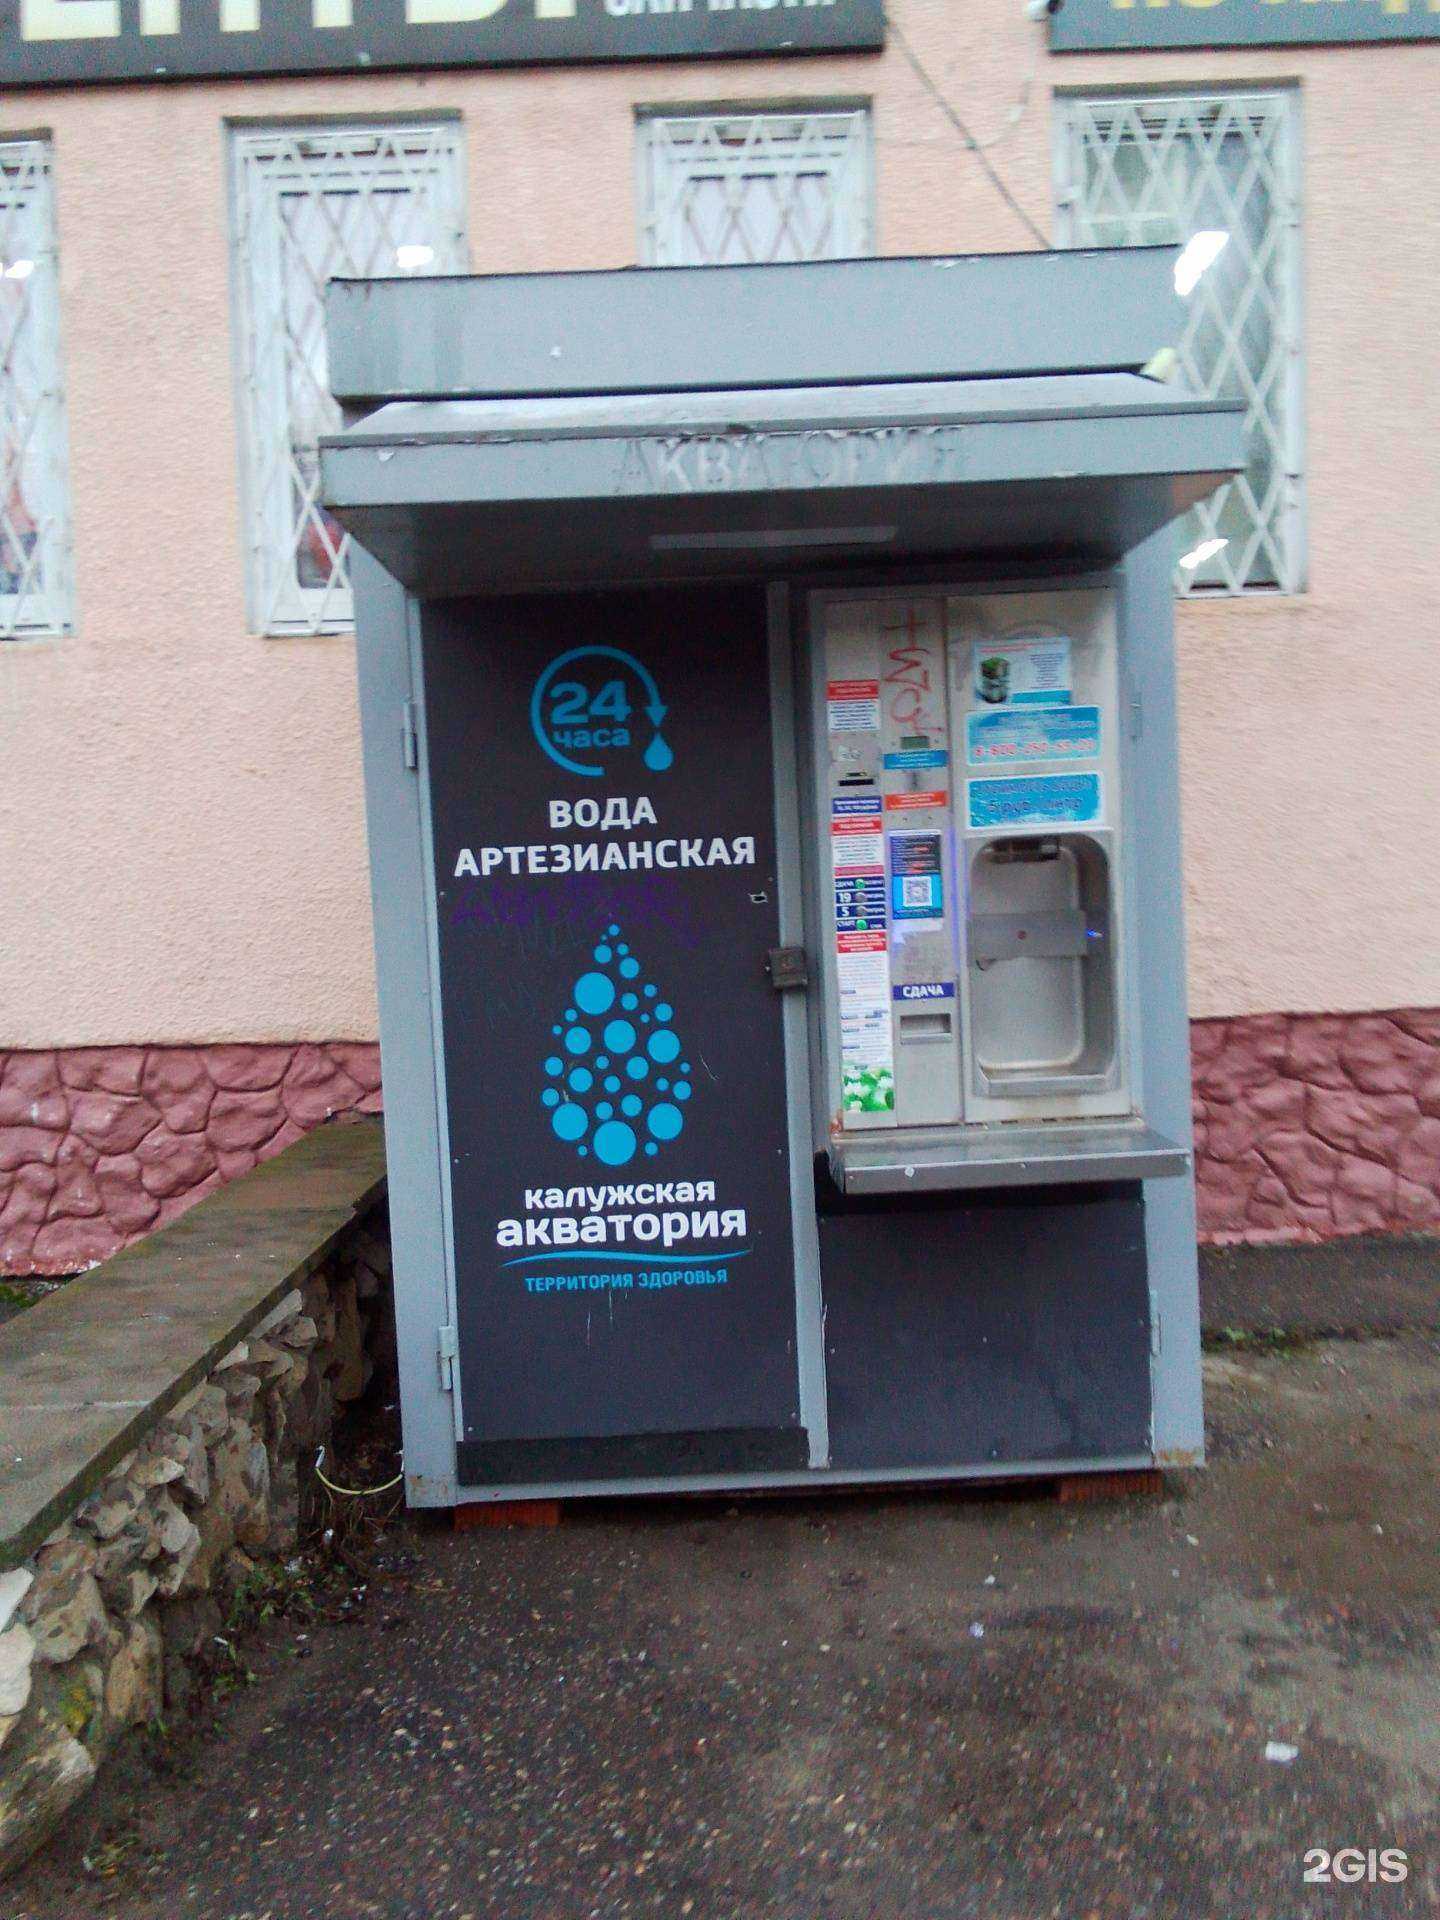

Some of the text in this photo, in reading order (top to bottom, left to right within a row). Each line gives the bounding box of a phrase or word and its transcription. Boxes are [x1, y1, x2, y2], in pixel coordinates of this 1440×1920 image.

[549, 680, 632, 725] 24
[552, 727, 631, 749] часа
[548, 796, 658, 831] ВОДА
[453, 836, 756, 877] АРТЕЗИАНСКАЯ
[902, 984, 945, 999] СДАЧА
[524, 1180, 716, 1212] калужская
[496, 1209, 747, 1247] акватория
[524, 1268, 729, 1293] ТЕРРИТОРИЯ ЗДОРОВЬЯ
